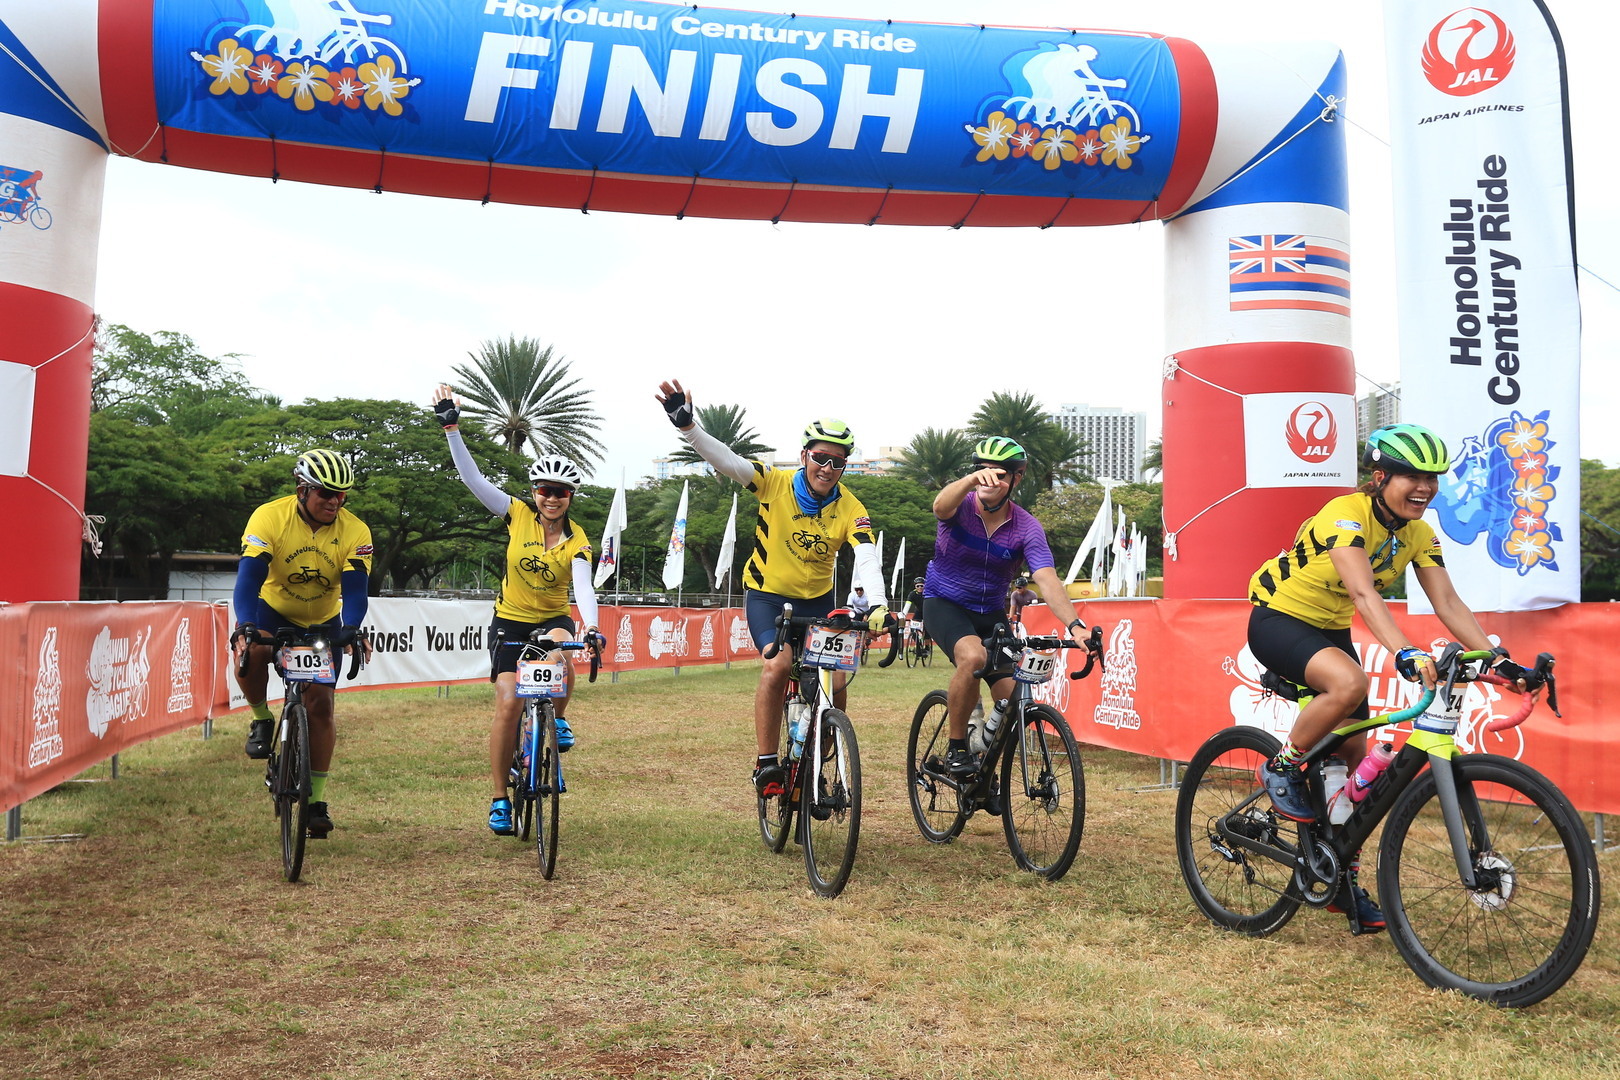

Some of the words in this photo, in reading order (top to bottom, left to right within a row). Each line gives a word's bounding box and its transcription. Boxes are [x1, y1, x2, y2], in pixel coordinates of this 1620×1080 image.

[484, 0, 657, 31] Honolulu
[671, 15, 826, 51] Century
[833, 29, 917, 53] Ride
[1447, 67, 1499, 89] JAL
[464, 32, 924, 154] FINISH
[1418, 111, 1461, 125] JAPAN
[1463, 104, 1525, 117] AIRLINES
[1477, 154, 1512, 241] Ride
[1443, 198, 1482, 366] Honolulu
[1487, 248, 1522, 405] Century
[1302, 445, 1331, 457] JAL
[425, 625, 454, 652] You
[459, 625, 482, 651] did
[824, 636, 844, 652] 55
[294, 654, 322, 668] 103
[533, 668, 552, 683] 69
[1102, 692, 1133, 710] Honolulu
[1095, 706, 1121, 728] Century
[1121, 711, 1140, 728] Ride
